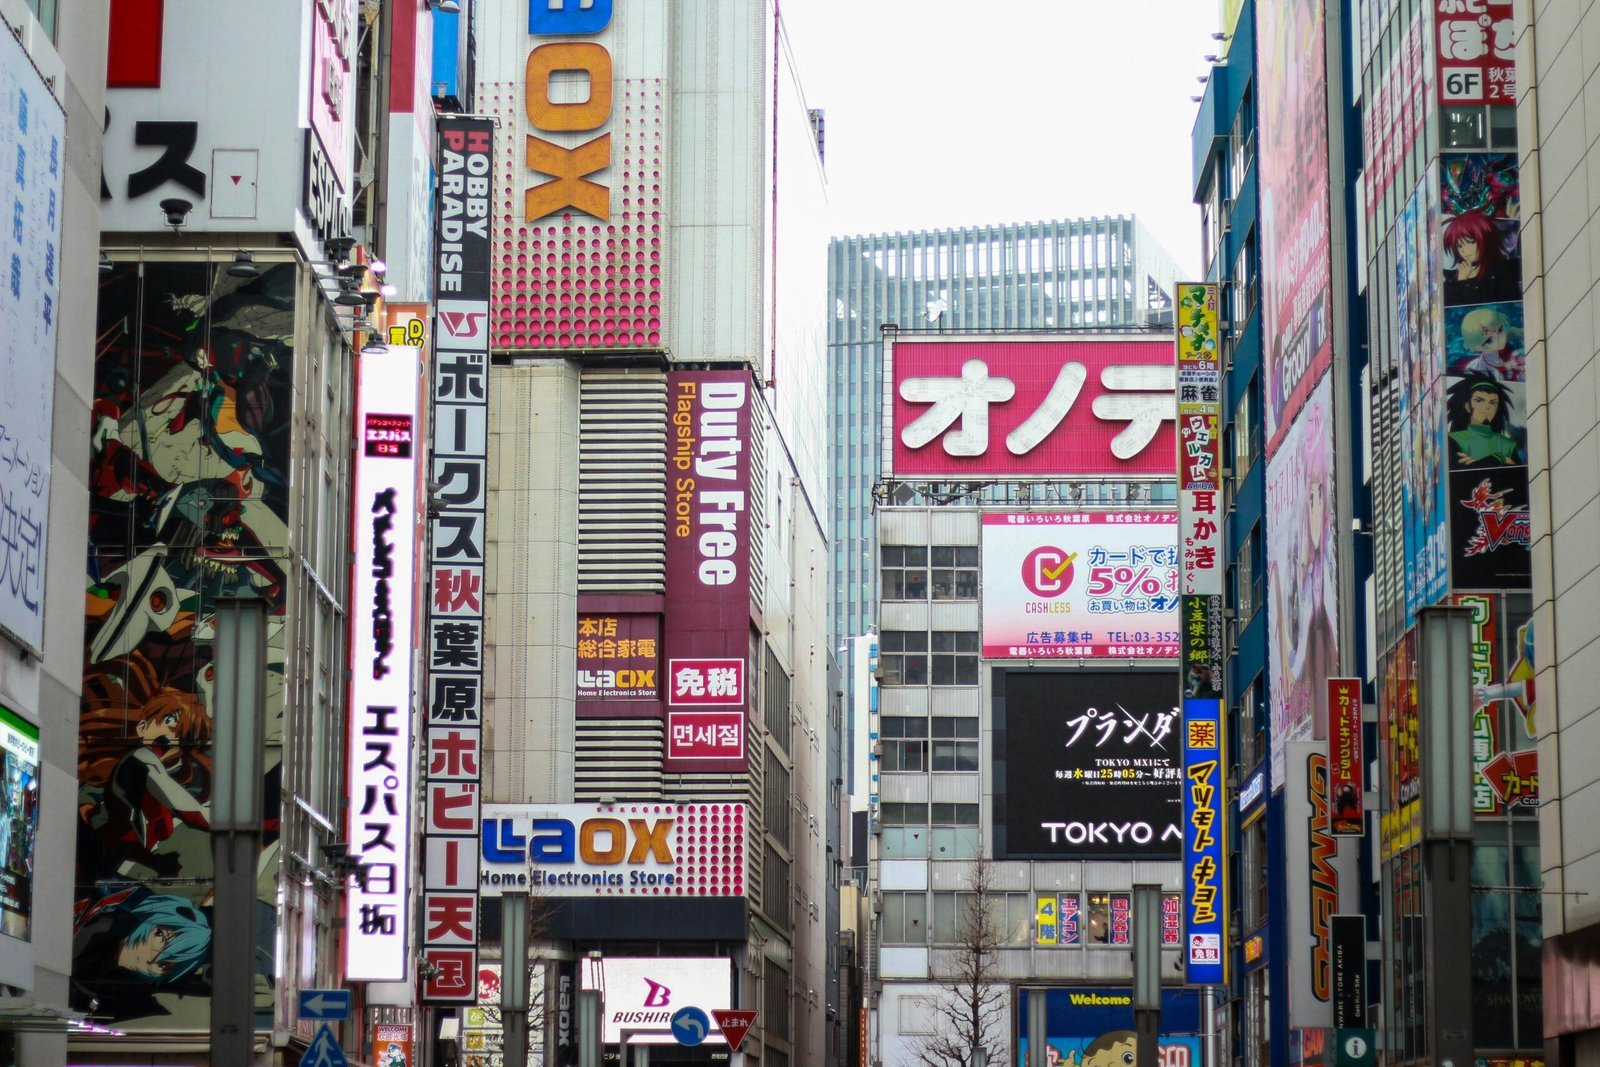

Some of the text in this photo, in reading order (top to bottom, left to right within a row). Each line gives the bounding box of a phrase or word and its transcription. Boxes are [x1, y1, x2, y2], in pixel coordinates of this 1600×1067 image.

[1446, 73, 1479, 95] 6F
[466, 131, 490, 239] HOBBY
[440, 130, 465, 292] PARADISE
[1181, 385, 1218, 401] 麻雀
[366, 429, 411, 442] エスパス
[673, 382, 696, 537] Flagship Store
[695, 382, 746, 585] Duty Free
[1192, 491, 1218, 570] 耳かき
[1184, 537, 1195, 595] もみほぐし
[1025, 602, 1071, 613] CASHLESS
[578, 617, 618, 637] 本店
[1026, 631, 1093, 644] 広告募集中
[578, 639, 656, 658] 総合家電
[675, 667, 738, 697] 免税
[673, 724, 739, 747] 면세점
[1189, 721, 1216, 748] 薬
[1095, 758, 1130, 767] TOKYO
[1041, 822, 1153, 844] TOKYO
[481, 869, 675, 886] Home Electronics Store
[1040, 902, 1056, 940] 4階
[1062, 898, 1079, 943] エアコン
[1112, 899, 1128, 943] 暖房器具
[1163, 900, 1179, 943] 加湿器
[1070, 993, 1131, 1006] Welcome
[721, 1017, 749, 1029] 止まれ
